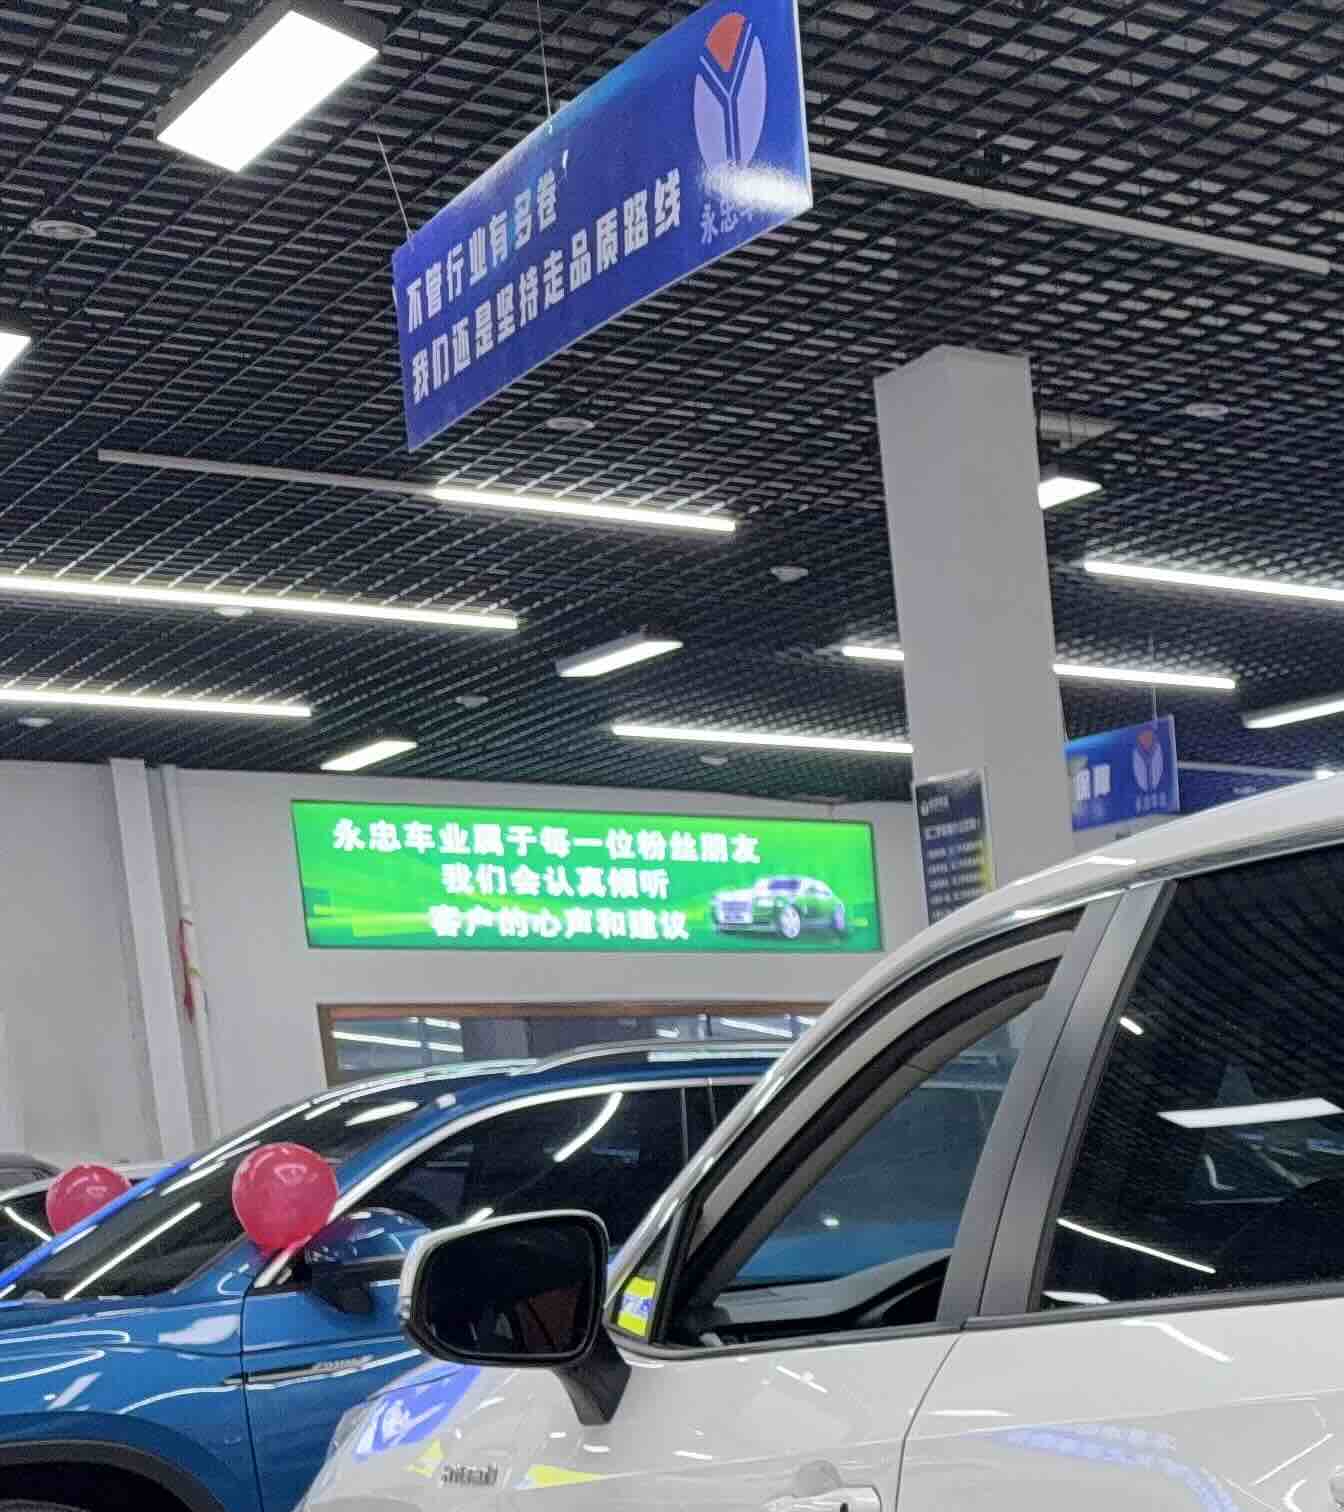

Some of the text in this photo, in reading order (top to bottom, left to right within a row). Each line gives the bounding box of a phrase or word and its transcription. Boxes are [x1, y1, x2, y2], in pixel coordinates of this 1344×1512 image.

[412, 167, 681, 404] 我们还是坚持走品质路线
[332, 817, 761, 864] 永忠车业属于每一位粉丝朋友
[440, 862, 669, 898] 我们会认真倾听
[429, 903, 690, 940] 客户的心声和建议
